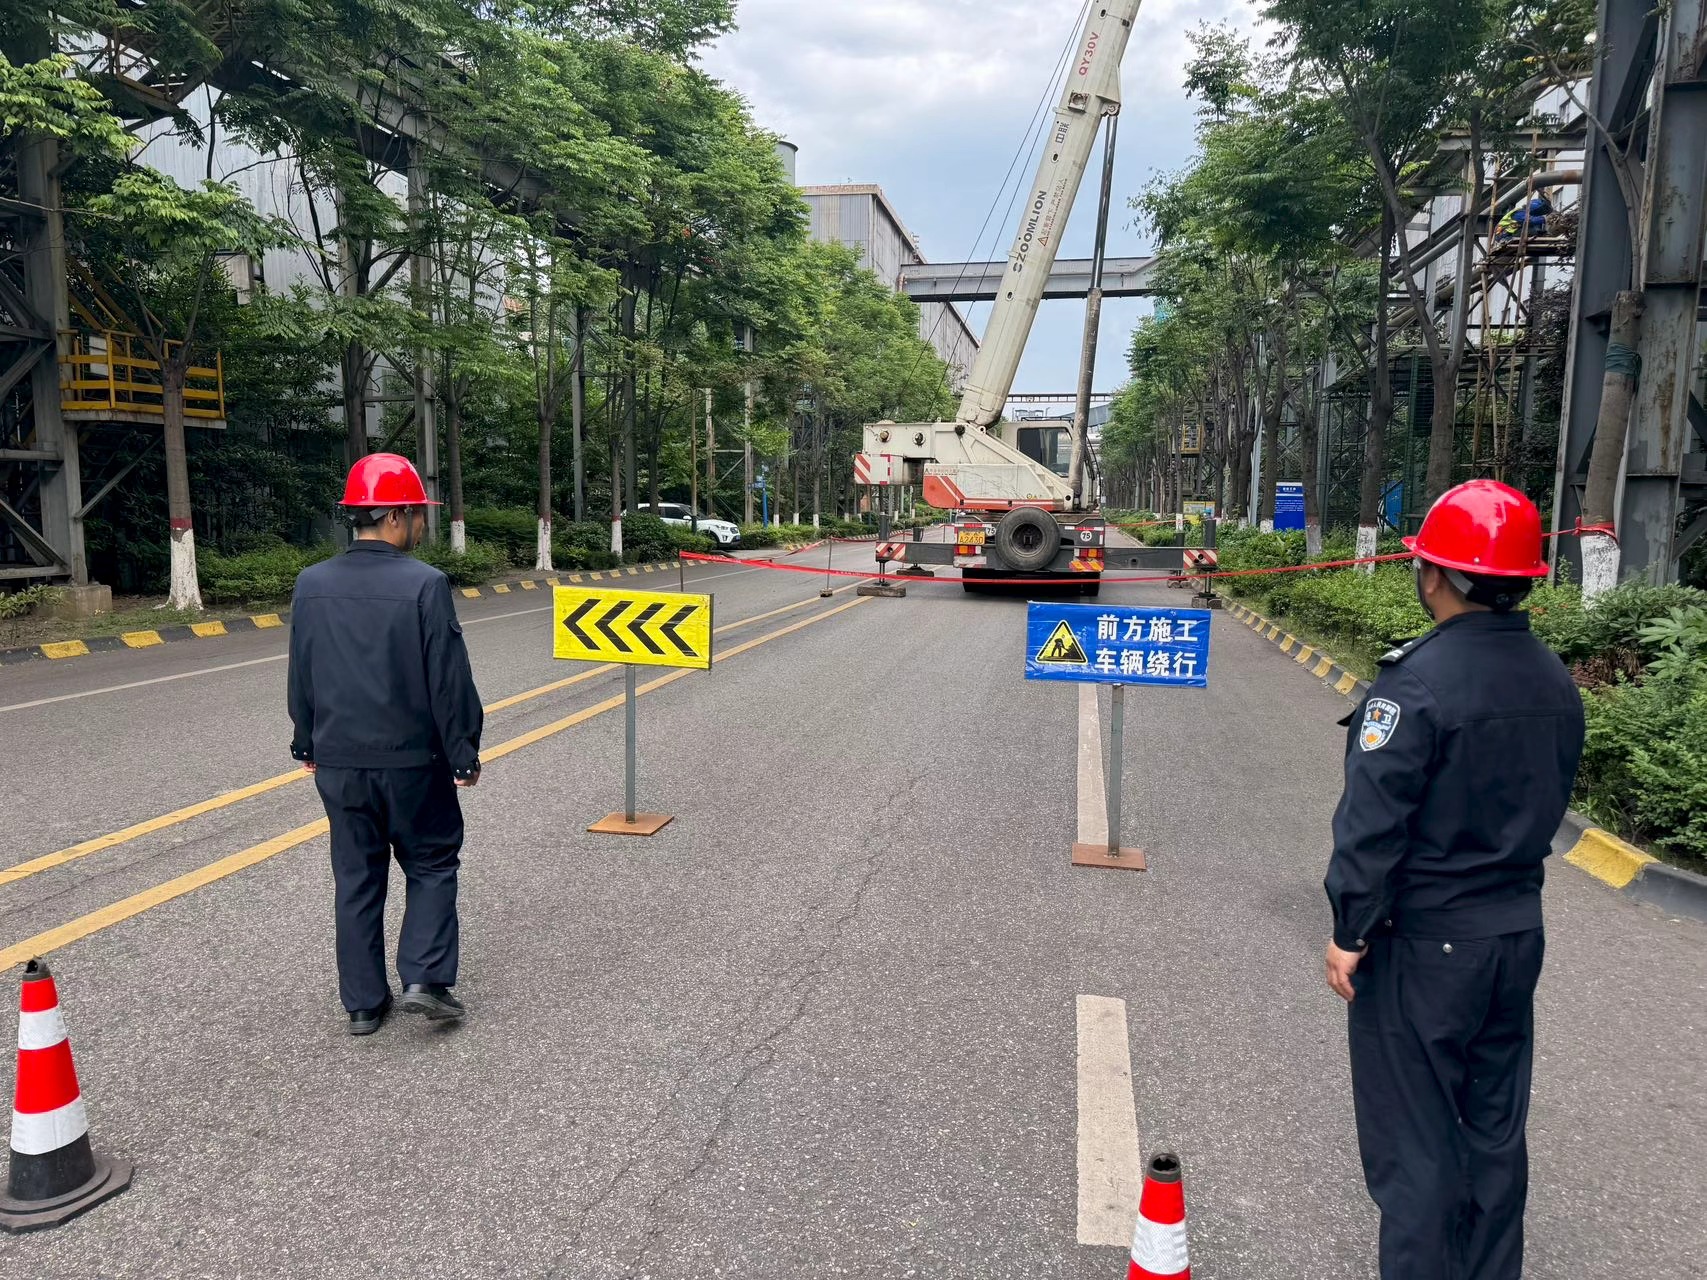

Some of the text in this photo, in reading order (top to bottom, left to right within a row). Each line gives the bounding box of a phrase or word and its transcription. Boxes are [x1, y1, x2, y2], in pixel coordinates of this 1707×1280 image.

[1078, 31, 1100, 76] QY30V
[1055, 122, 1070, 144] 中联
[1015, 190, 1048, 262] ZOOMLION
[986, 527, 996, 535] 75
[1081, 532, 1091, 540] 75
[1096, 614, 1198, 643] 前方施工
[1095, 648, 1198, 677] 车辆绕行
